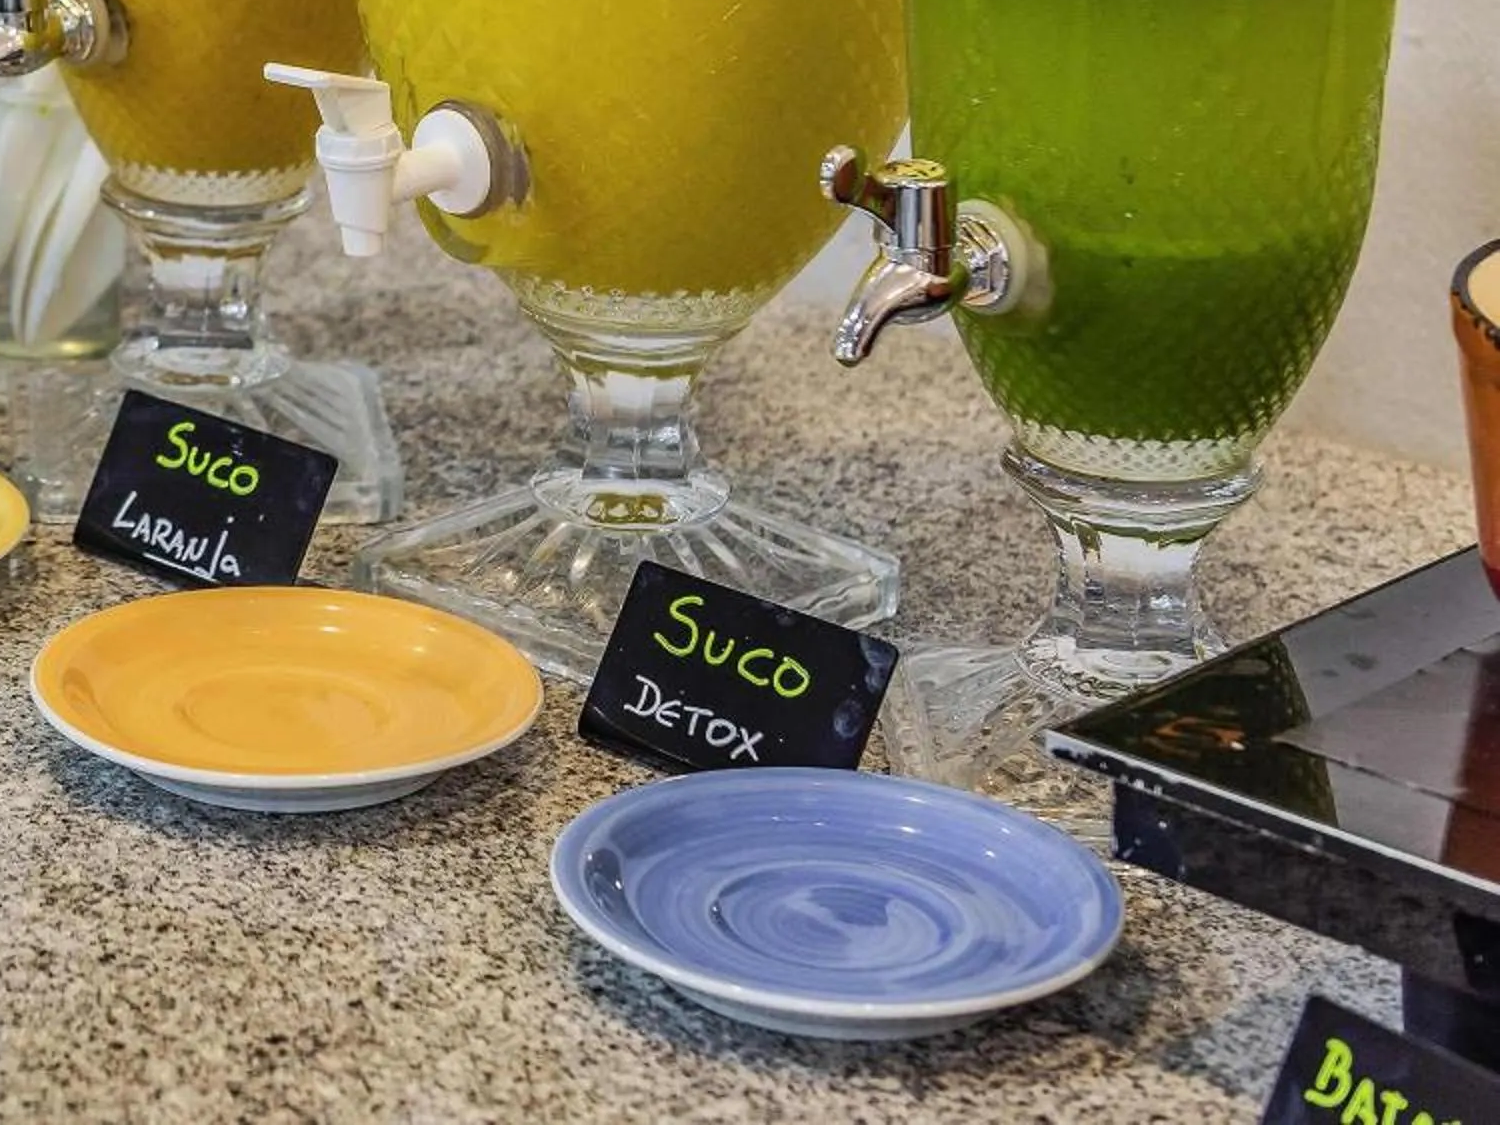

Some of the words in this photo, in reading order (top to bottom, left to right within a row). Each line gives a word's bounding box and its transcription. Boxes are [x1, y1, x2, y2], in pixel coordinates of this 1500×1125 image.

[156, 422, 260, 496] Suco
[653, 596, 811, 698] Suco
[623, 674, 765, 762] DETOX
[1304, 1038, 1463, 1125] BAT
